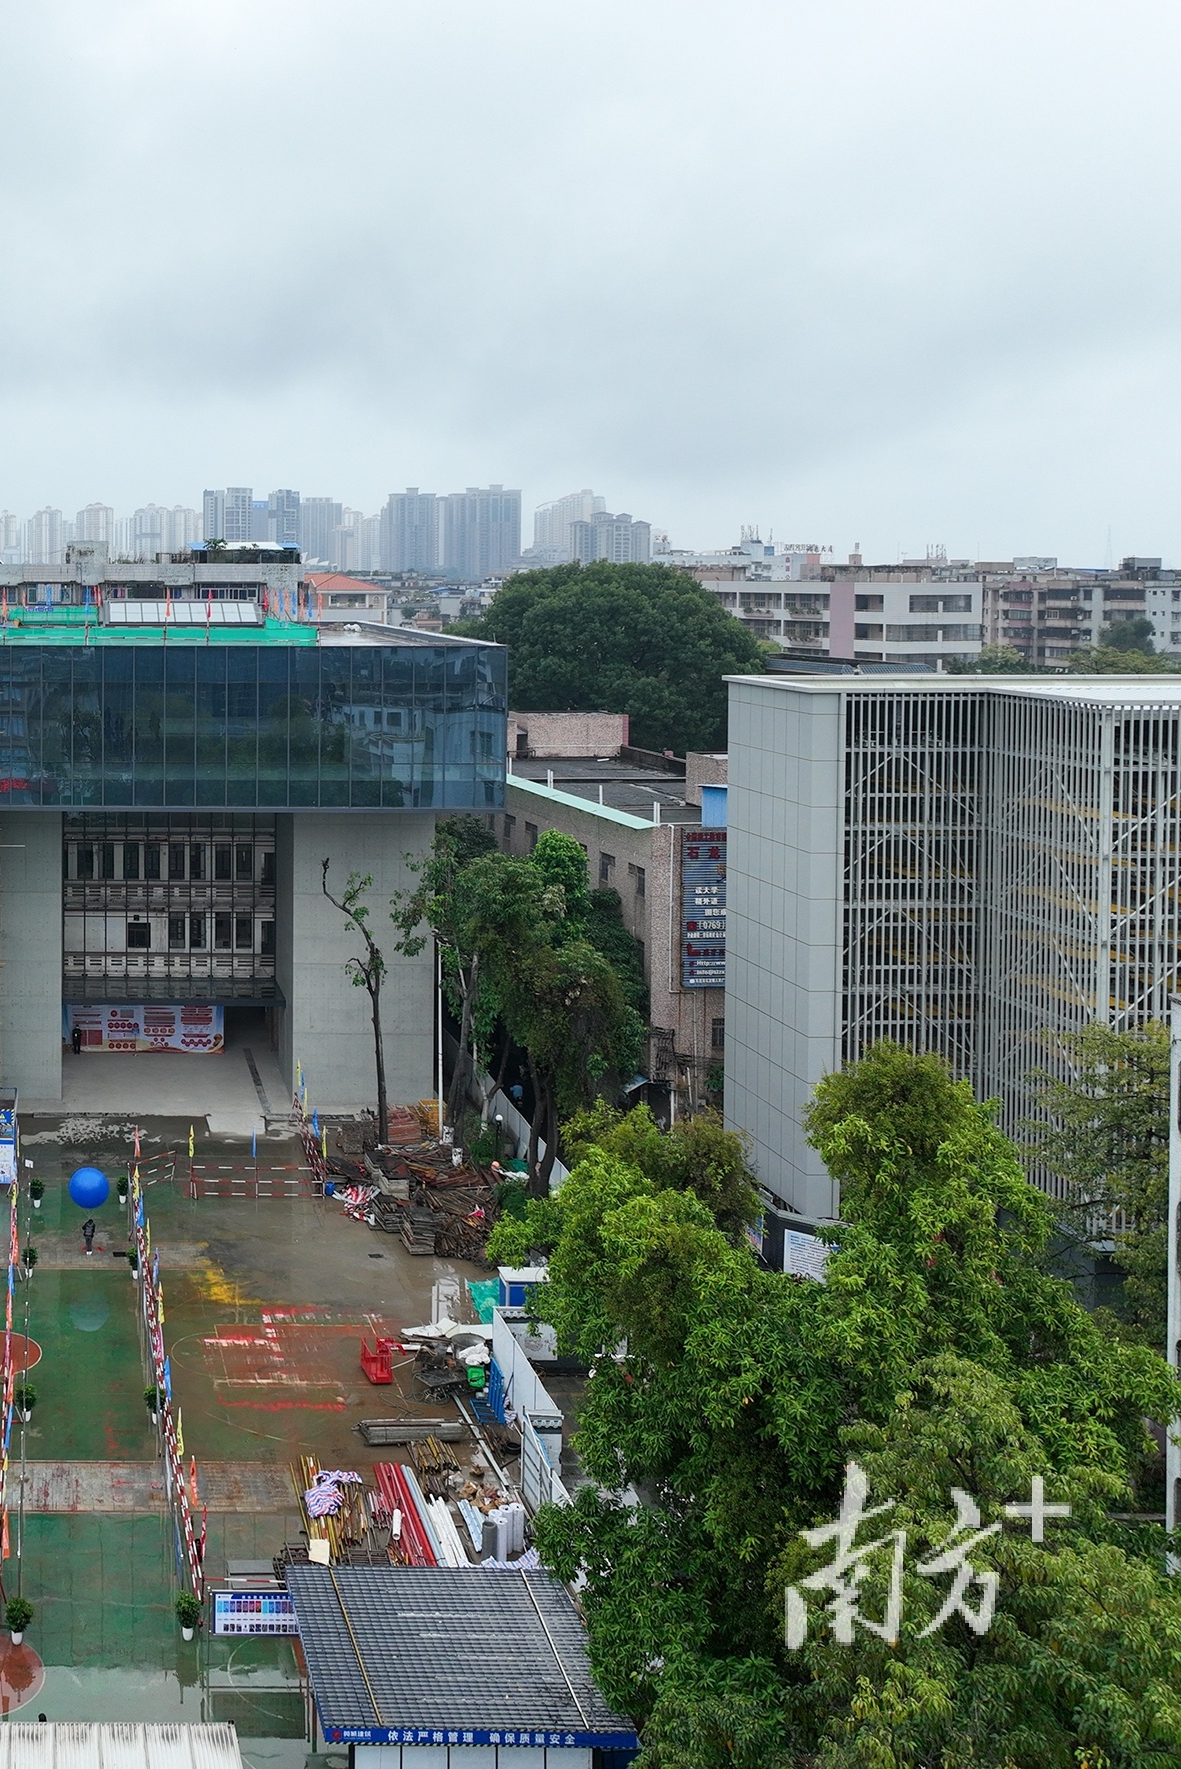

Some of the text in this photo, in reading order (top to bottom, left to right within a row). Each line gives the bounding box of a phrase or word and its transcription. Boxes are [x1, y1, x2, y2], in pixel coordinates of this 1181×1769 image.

[388, 1730, 474, 1743] 依法严格管理
[489, 1732, 576, 1745] 确保质量安全
